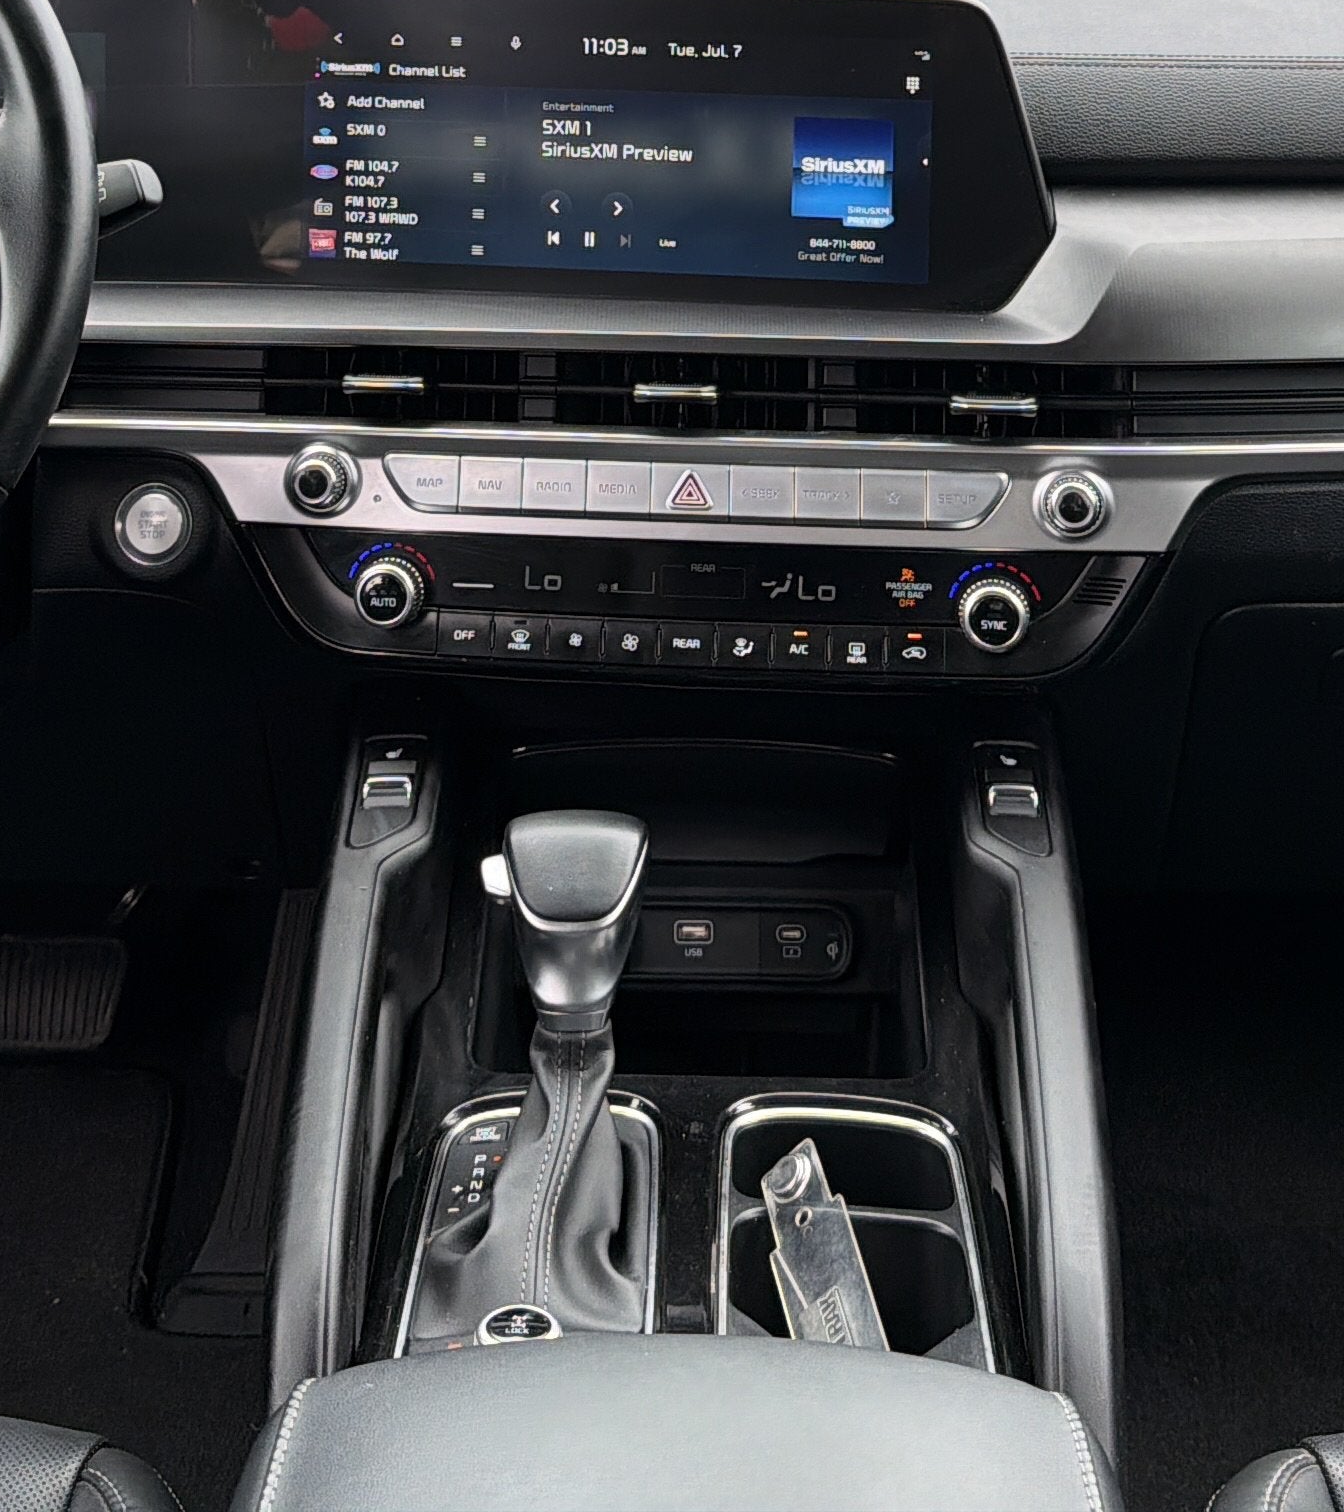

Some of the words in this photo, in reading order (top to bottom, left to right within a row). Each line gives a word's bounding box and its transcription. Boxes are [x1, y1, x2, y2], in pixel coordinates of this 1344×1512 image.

[582, 37, 630, 56] 11:03
[632, 45, 647, 55] AM
[732, 44, 743, 59] 7
[388, 62, 440, 77] Channel
[442, 64, 467, 78] List
[347, 95, 373, 108] Add
[374, 96, 425, 110] Channel
[542, 101, 615, 113] Entertainment
[347, 123, 375, 137] SXM
[376, 124, 387, 137] 0
[542, 119, 581, 136] SXM
[584, 120, 592, 136] 1
[541, 141, 618, 160] SiriusXM
[622, 143, 693, 162] Preview
[345, 159, 365, 172] FM
[367, 160, 400, 173] 104.7
[800, 155, 886, 175] SiriusXM
[345, 175, 386, 188] K104.7
[344, 195, 364, 208] FM
[367, 196, 399, 210] 107.3
[344, 210, 376, 224] 107.3
[344, 231, 364, 244] FM
[365, 232, 393, 245] 97.7
[343, 246, 368, 260] The
[370, 247, 400, 261] Wolf
[797, 251, 827, 262] Great
[829, 252, 857, 263] Offer
[859, 253, 885, 265] Now!
[416, 477, 444, 488] MAP
[478, 479, 503, 490] NAV
[536, 481, 572, 493] RADIO
[599, 483, 637, 494] MEDIA
[936, 493, 976, 505] SETUP
[140, 530, 166, 540] STOP
[690, 563, 716, 573] REAR
[885, 581, 933, 591] PASSENGER
[891, 590, 907, 599] AIR
[907, 590, 924, 600] BAG
[369, 597, 397, 608] AUTO
[898, 599, 916, 608] OFF
[980, 620, 1008, 631] SYNC
[453, 629, 476, 641] OFF
[507, 642, 532, 652] FRONT
[672, 638, 701, 649] REAR
[789, 643, 809, 655] A/C
[846, 656, 867, 664] REAR
[684, 948, 703, 957] USB
[474, 1154, 487, 1165] P
[469, 1180, 484, 1190] N
[467, 1192, 481, 1204] D
[504, 1327, 530, 1335] LOCK
